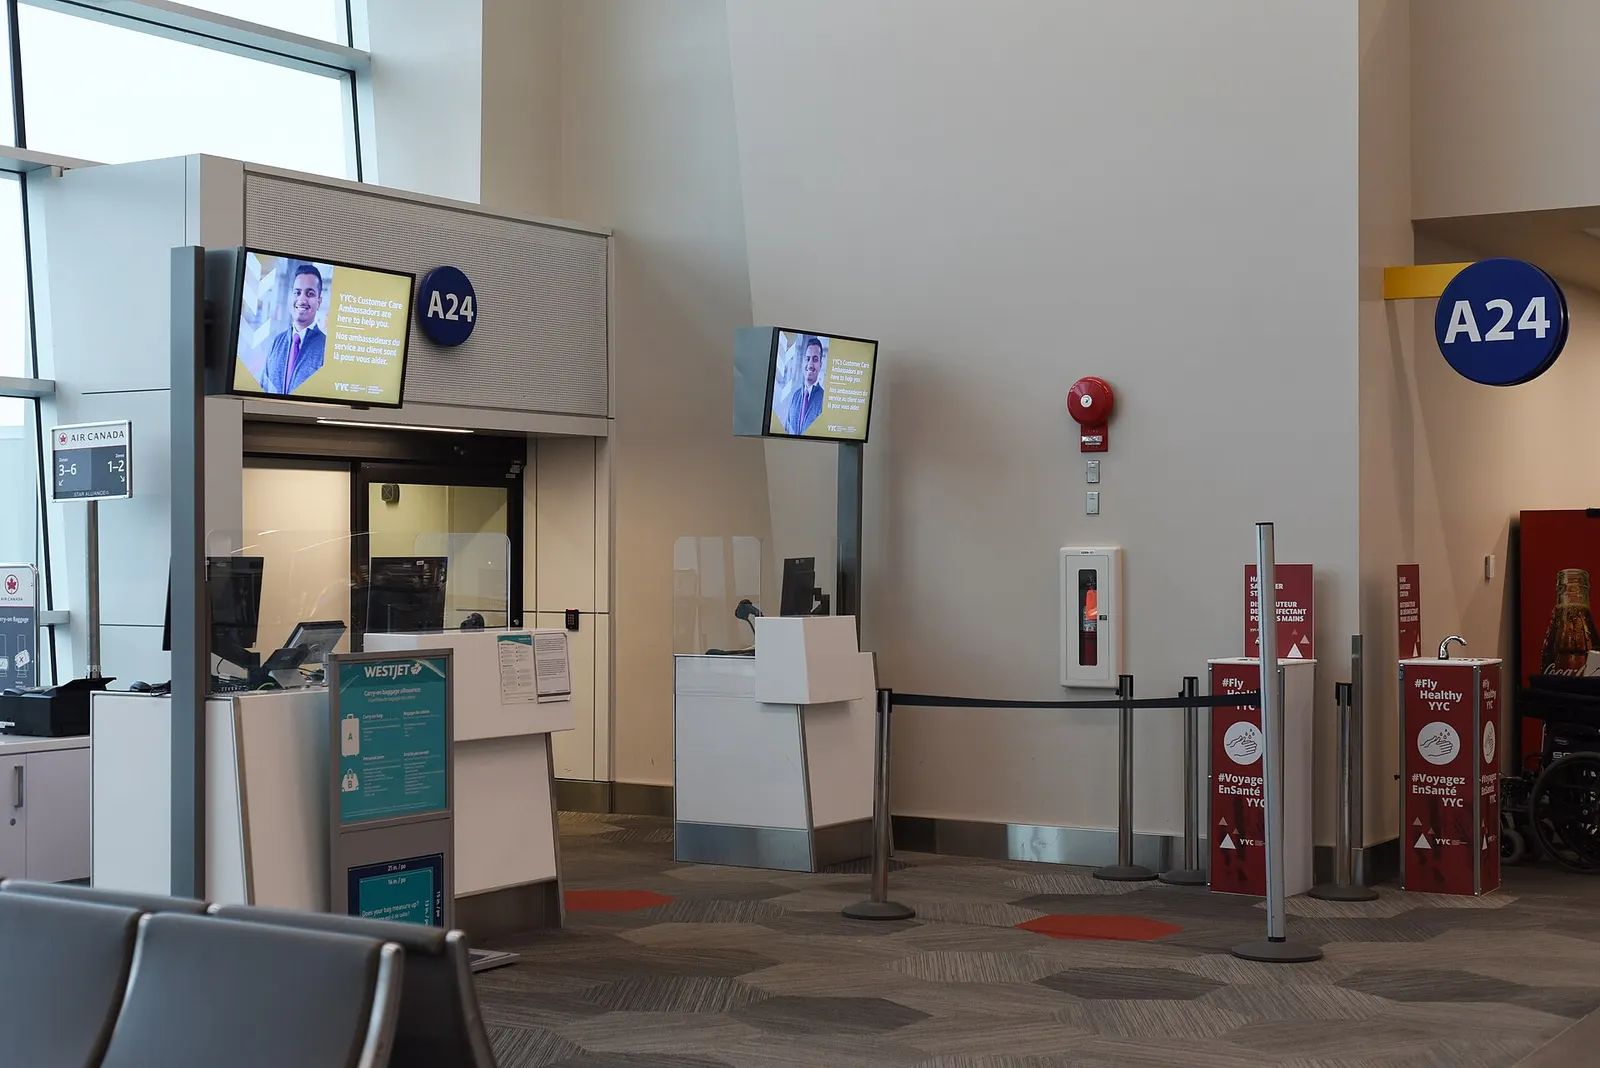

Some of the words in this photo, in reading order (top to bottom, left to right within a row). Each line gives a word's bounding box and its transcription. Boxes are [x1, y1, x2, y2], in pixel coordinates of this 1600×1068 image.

[340, 294, 356, 303] YYC's
[358, 296, 387, 307] Customer
[389, 301, 403, 309] Care
[428, 291, 473, 322] A24
[338, 304, 380, 317] Ambassadors
[337, 314, 352, 323] here
[362, 317, 375, 327] help
[1444, 297, 1550, 343] A24
[336, 332, 348, 340] Nos
[349, 334, 391, 345] ambassadeurs
[334, 343, 356, 351] service
[366, 346, 382, 354] client
[340, 354, 355, 363] pour
[334, 382, 349, 391] YYC
[71, 433, 85, 442] AIR
[88, 431, 124, 441] CANADA
[364, 664, 410, 680] WESTJET
[1222, 678, 1244, 690] #Fly
[1415, 679, 1437, 690] #Fly
[1420, 690, 1462, 703] Healthy
[1429, 702, 1450, 710] YYC
[1218, 773, 1263, 785] #Voyage
[1412, 774, 1465, 786] #Voyagez
[1219, 785, 1260, 796] EnSanté
[1412, 785, 1456, 796] EnSanté
[1442, 798, 1463, 807] YYC
[374, 908, 383, 916] your
[384, 906, 392, 914] bag
[392, 902, 411, 911] measure
[411, 900, 419, 909] up?
